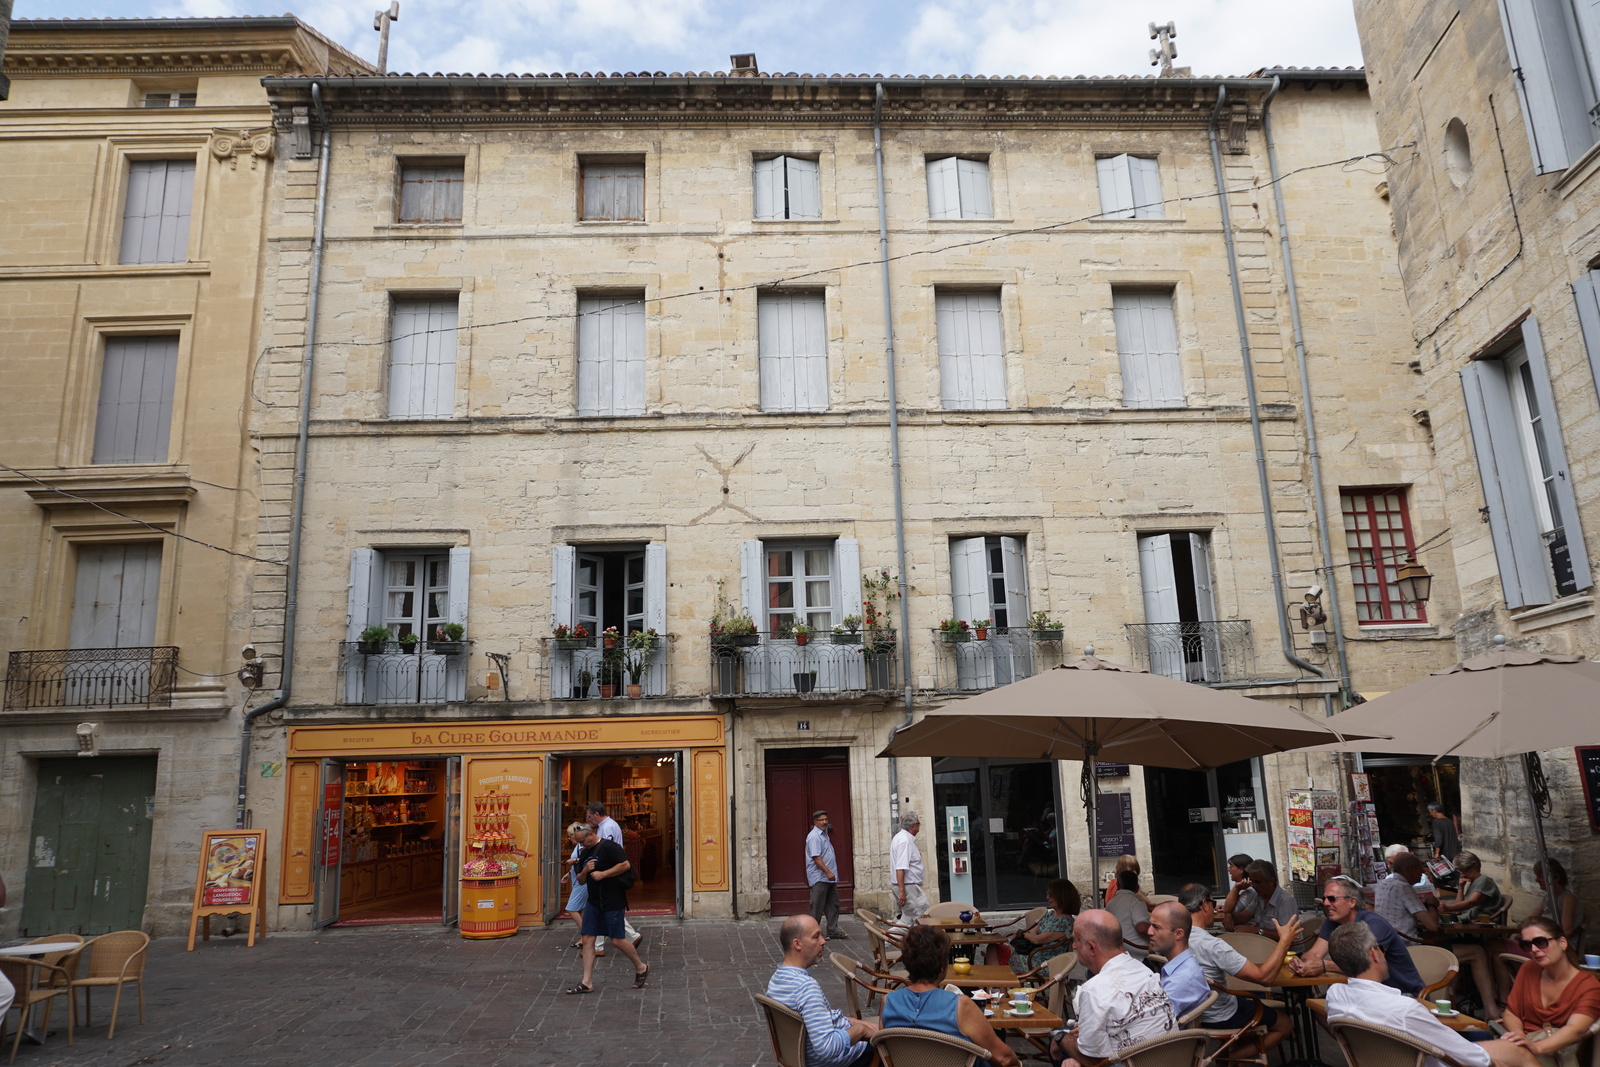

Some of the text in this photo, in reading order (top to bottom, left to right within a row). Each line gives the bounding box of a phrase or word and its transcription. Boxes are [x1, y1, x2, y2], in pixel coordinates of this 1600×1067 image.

[411, 729, 599, 745] LA CURE GOURMANDE
[479, 775, 504, 785] PRODUITS
